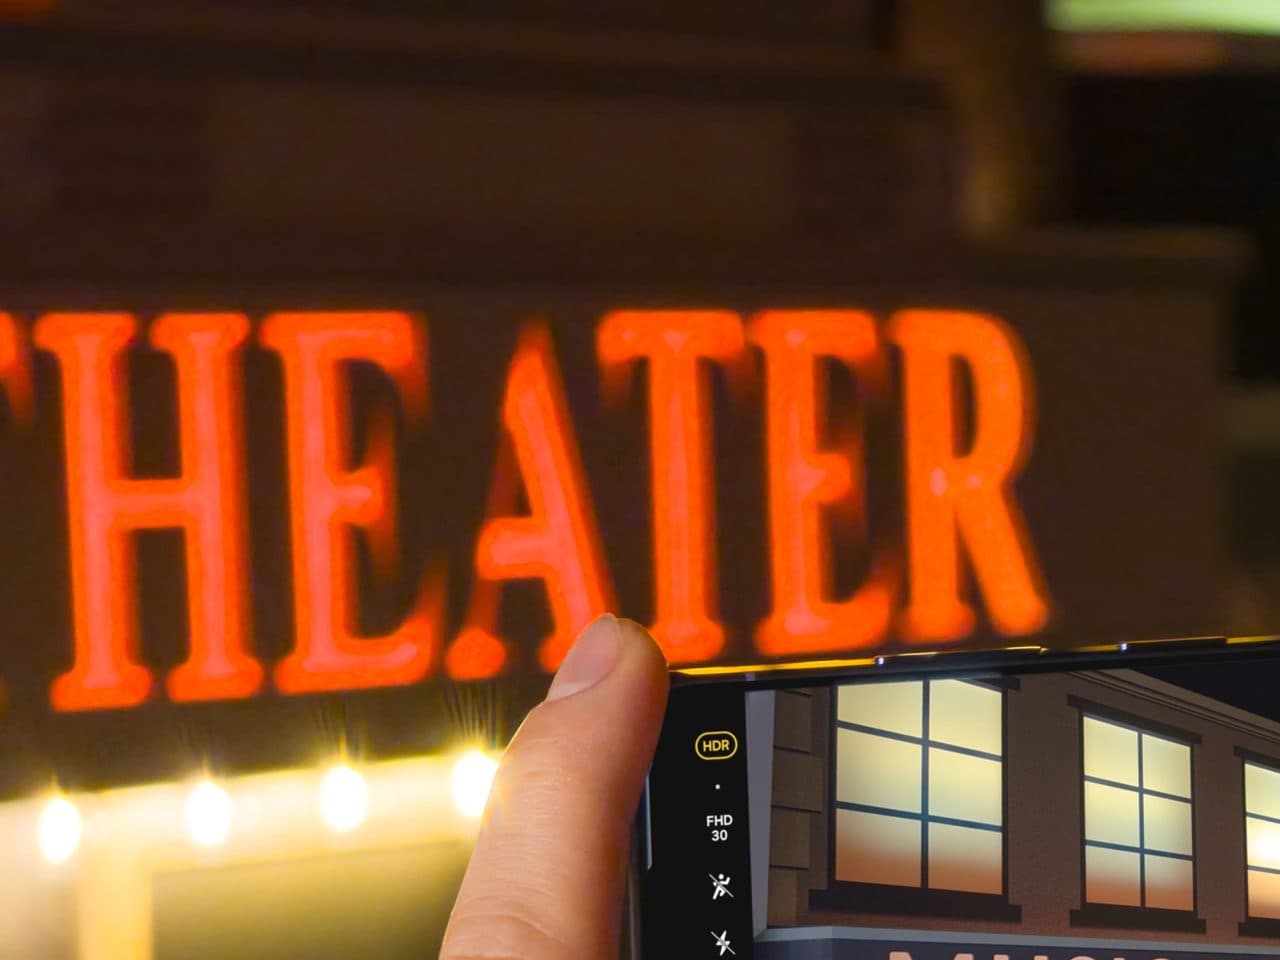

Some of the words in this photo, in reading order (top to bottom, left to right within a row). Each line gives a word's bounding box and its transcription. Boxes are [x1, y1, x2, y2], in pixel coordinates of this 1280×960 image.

[703, 739, 730, 752] HDR
[706, 814, 733, 827] FHD
[711, 829, 728, 842] 30
